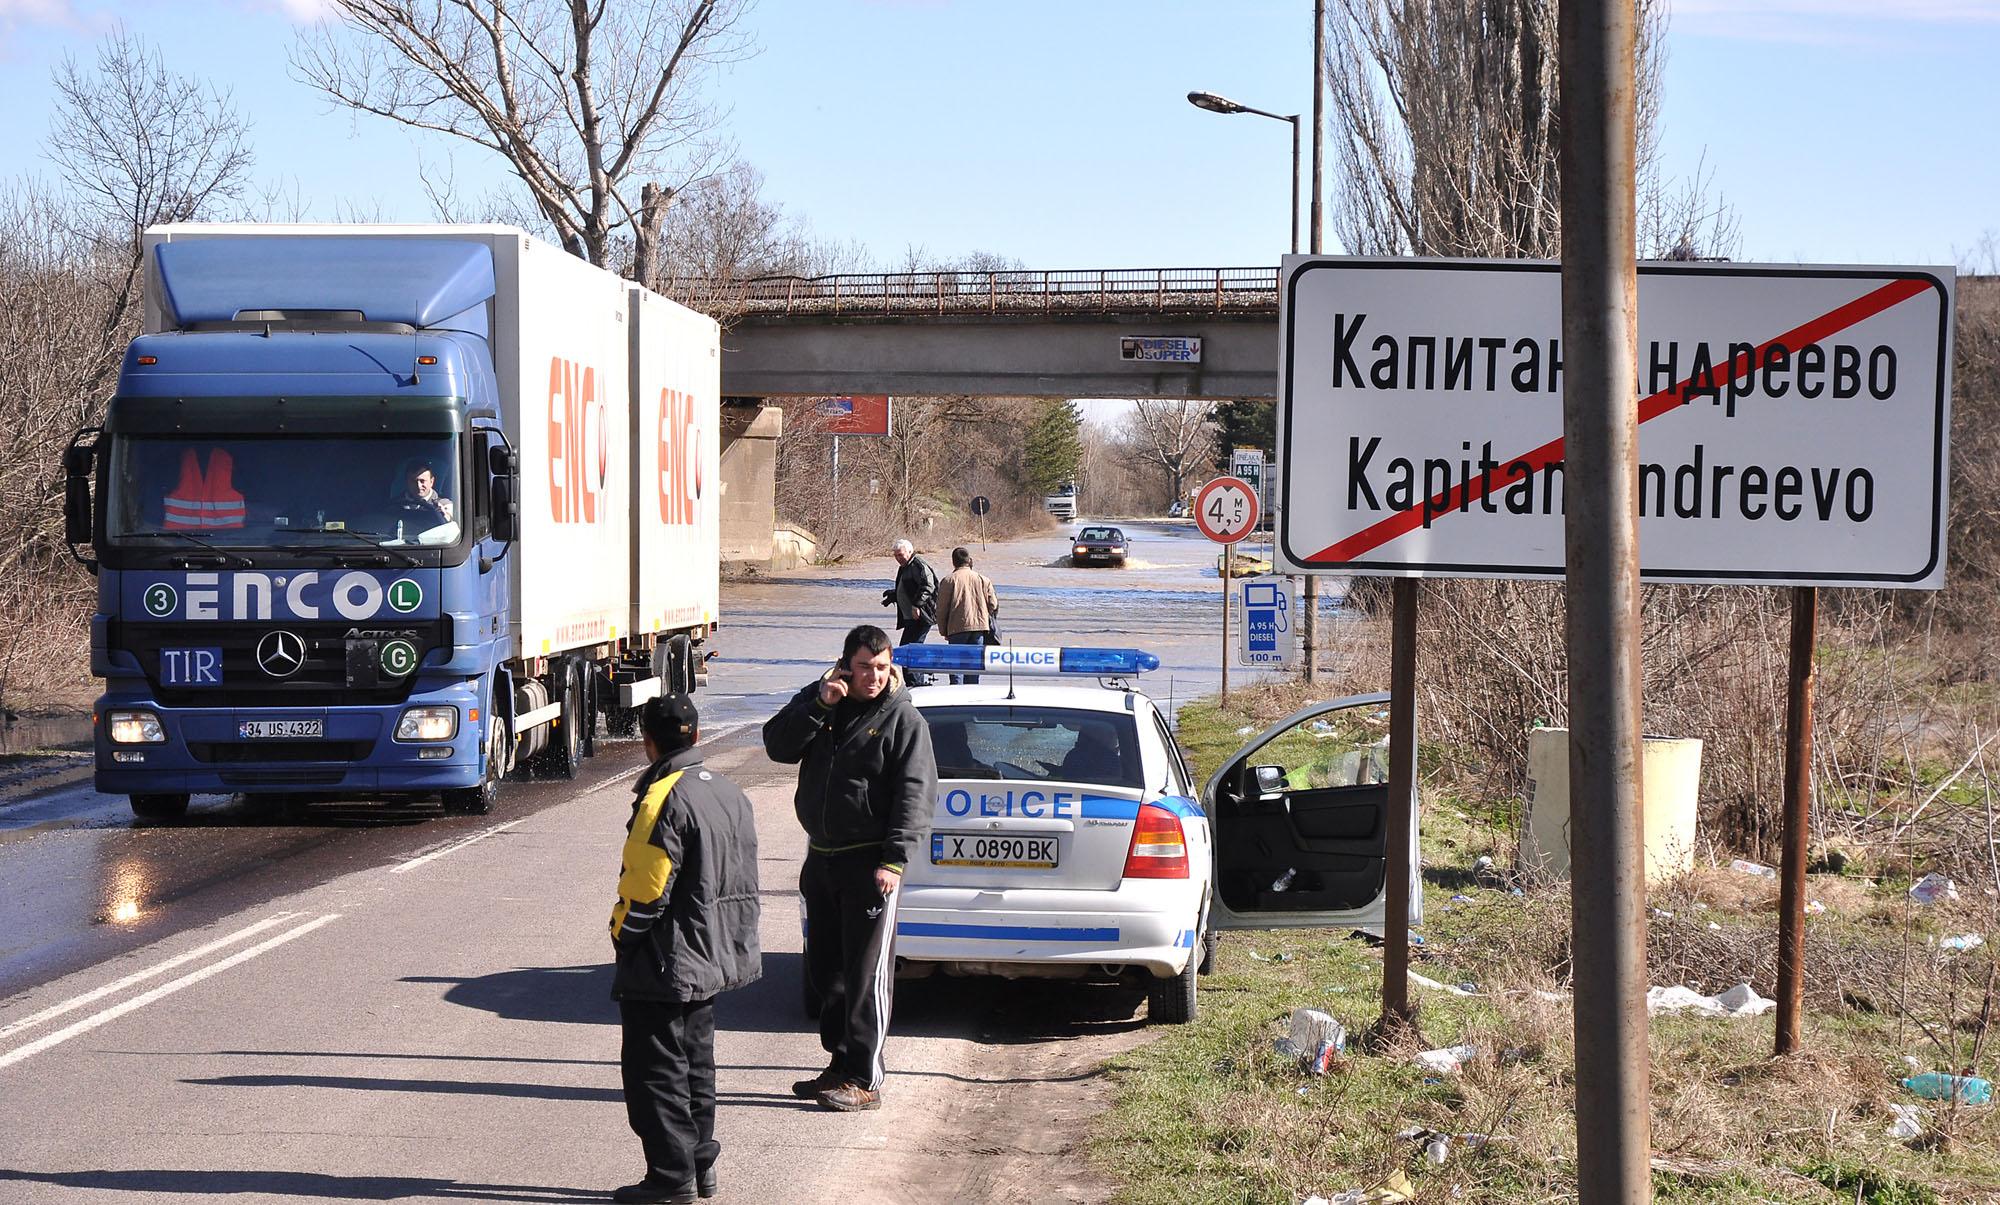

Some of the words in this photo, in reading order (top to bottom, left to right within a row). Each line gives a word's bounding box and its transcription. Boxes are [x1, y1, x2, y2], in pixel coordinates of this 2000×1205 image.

[1143, 339, 1189, 350] DIESEL
[1144, 350, 1191, 361] SUPER
[1638, 340, 1898, 418] ндреево
[1243, 465, 1253, 476] 95
[1347, 436, 1566, 529] Kapitan
[1638, 444, 1875, 523] ndreevo
[154, 589, 167, 609] 3
[397, 585, 412, 607] L
[1257, 622, 1267, 630] 95
[1250, 633, 1275, 642] DIESEL
[391, 647, 407, 668] G
[989, 651, 1055, 665] POLICE
[1249, 653, 1269, 661] 100
[164, 650, 217, 683] TIR
[247, 722, 262, 736] 34
[269, 722, 283, 736] US
[289, 722, 319, 736] 4322
[937, 789, 1073, 818] OLICE
